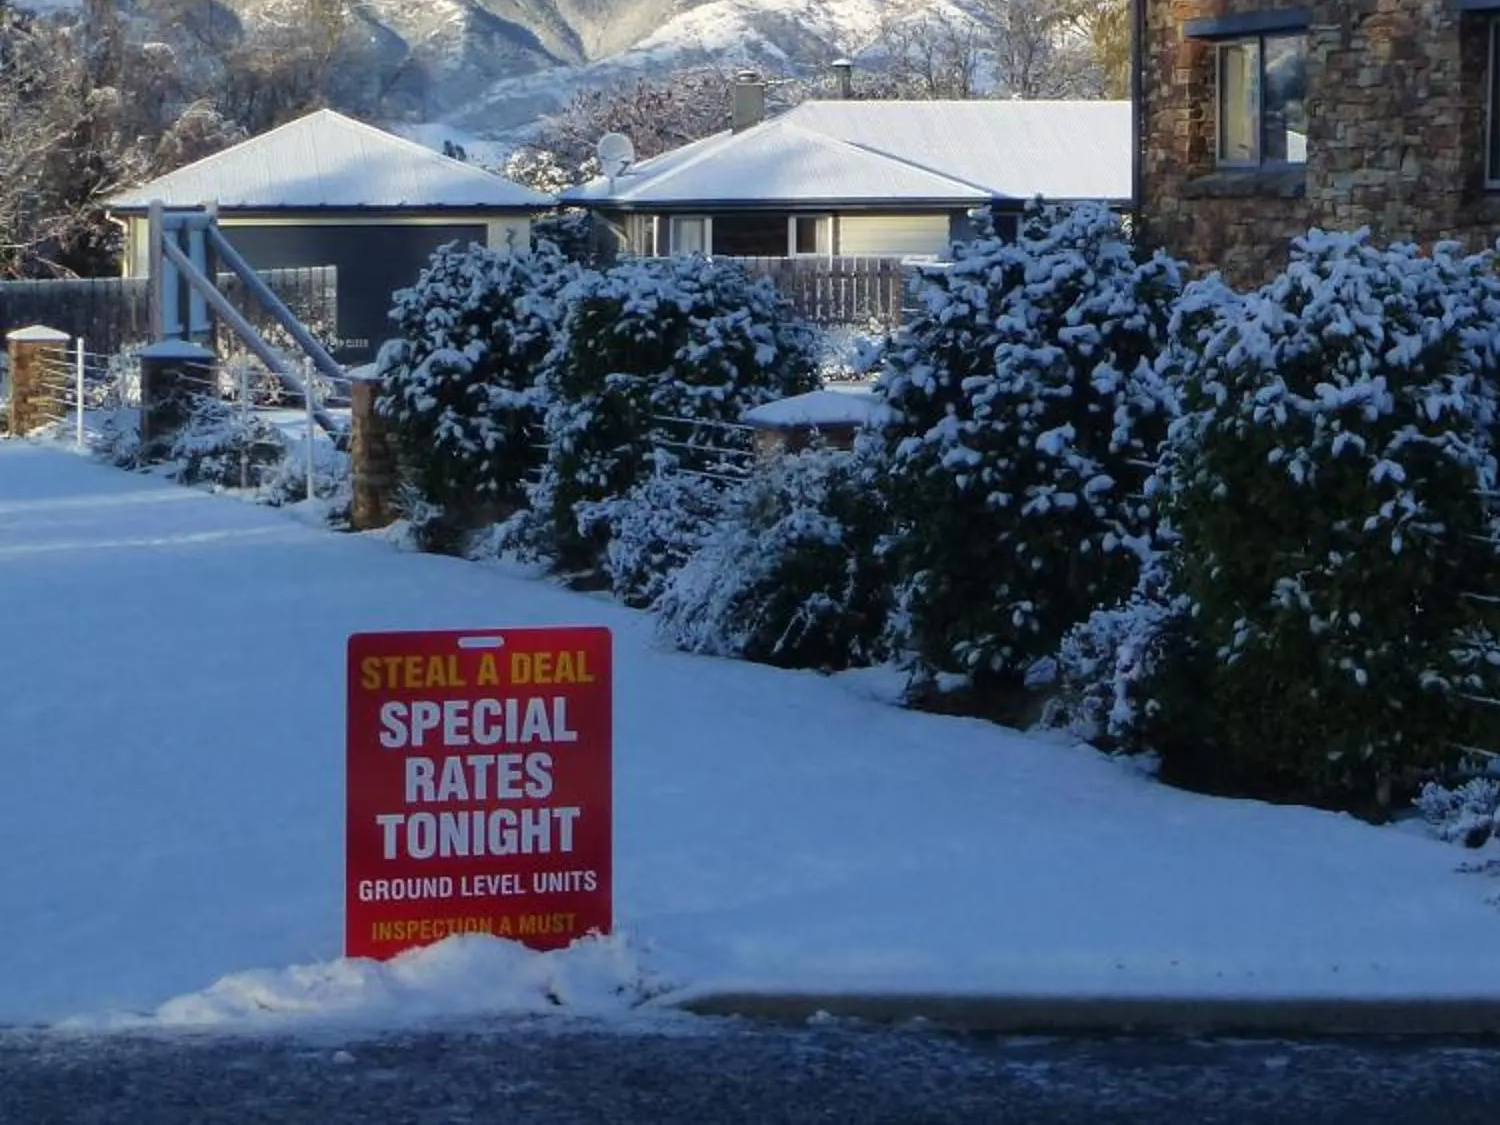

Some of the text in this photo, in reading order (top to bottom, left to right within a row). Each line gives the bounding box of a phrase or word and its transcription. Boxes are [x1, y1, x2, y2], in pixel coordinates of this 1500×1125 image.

[361, 651, 594, 690] STEAL A DEAL
[379, 696, 578, 749] SPECIAL
[405, 752, 553, 803] RATES
[376, 807, 581, 860] TONIGHT
[359, 870, 598, 901] GROUND LEVEL UNITS
[499, 915, 512, 935] A
[518, 913, 577, 935] MUST
